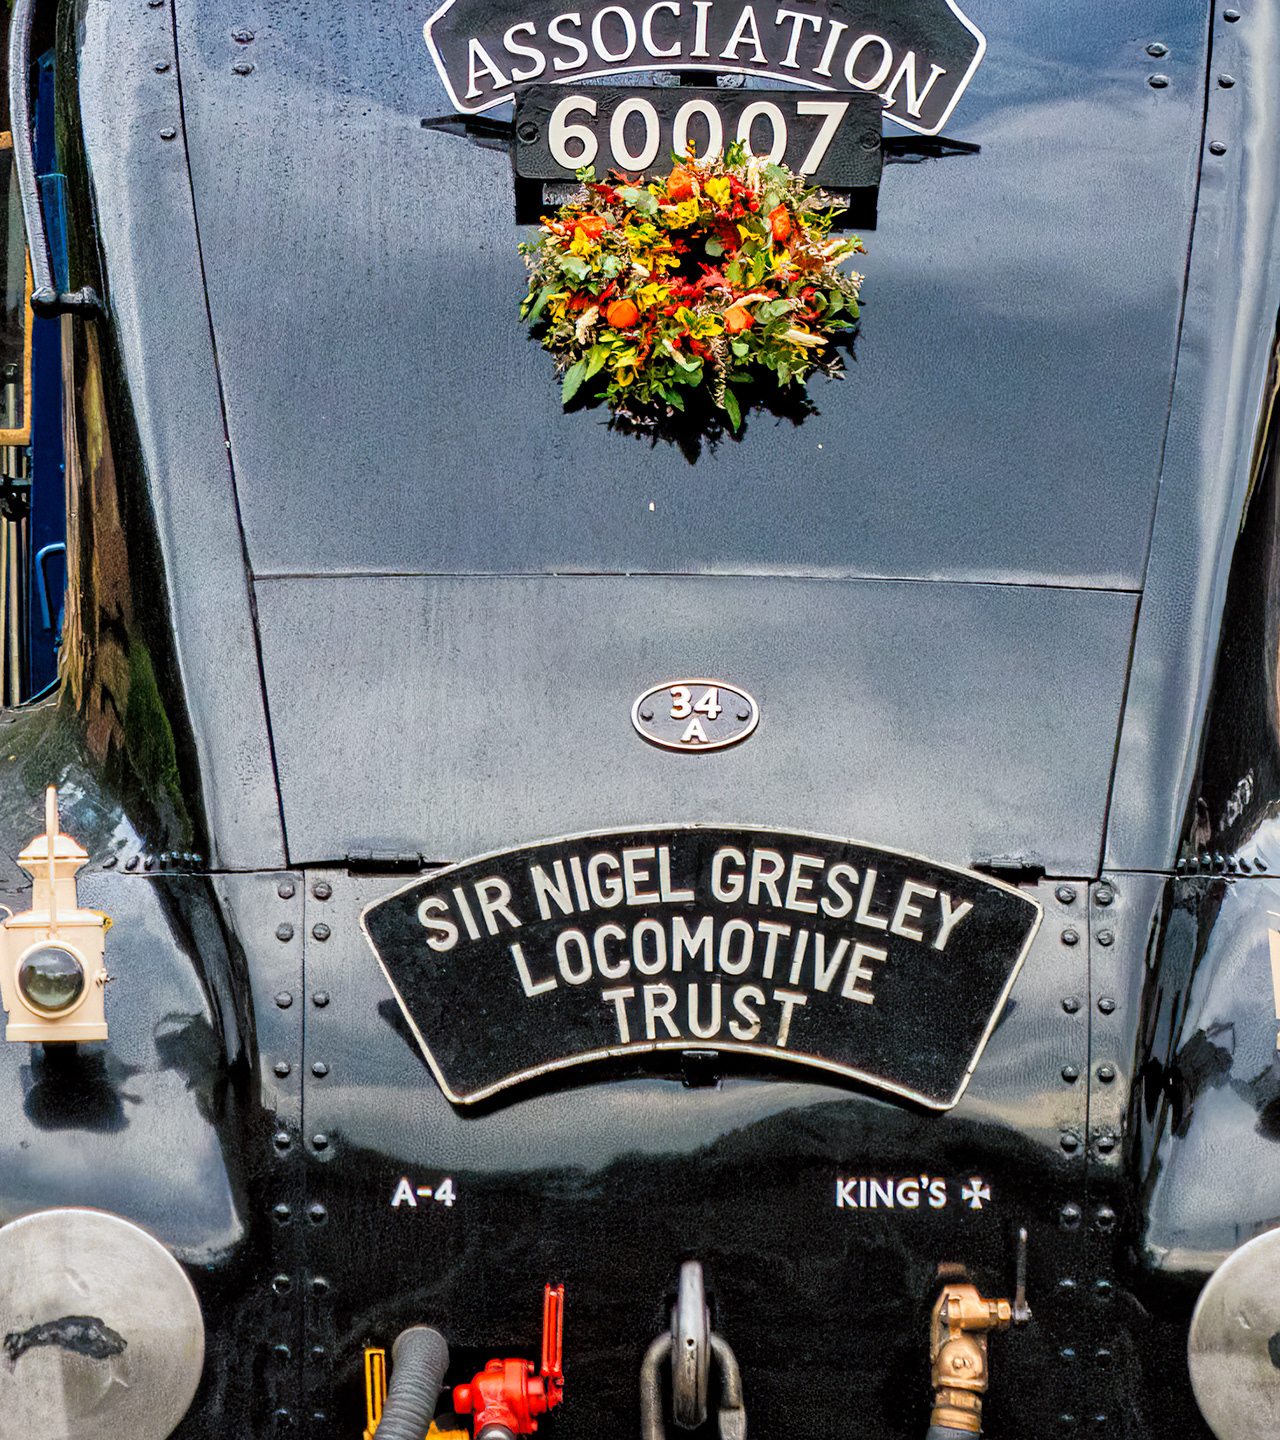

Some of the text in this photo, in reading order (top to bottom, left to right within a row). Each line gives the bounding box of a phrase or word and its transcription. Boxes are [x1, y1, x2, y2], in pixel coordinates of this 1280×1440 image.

[464, 0, 947, 118] ASSOCIATION
[547, 96, 851, 175] 60007
[670, 686, 722, 720] 34
[680, 717, 709, 743] A
[417, 846, 973, 952] SIR NIGEL GRESLEY
[511, 916, 887, 1005] LOCOMOTIVE
[603, 983, 807, 1046] TRUST
[391, 1177, 456, 1207] A-4
[835, 1177, 947, 1209] KING'S
